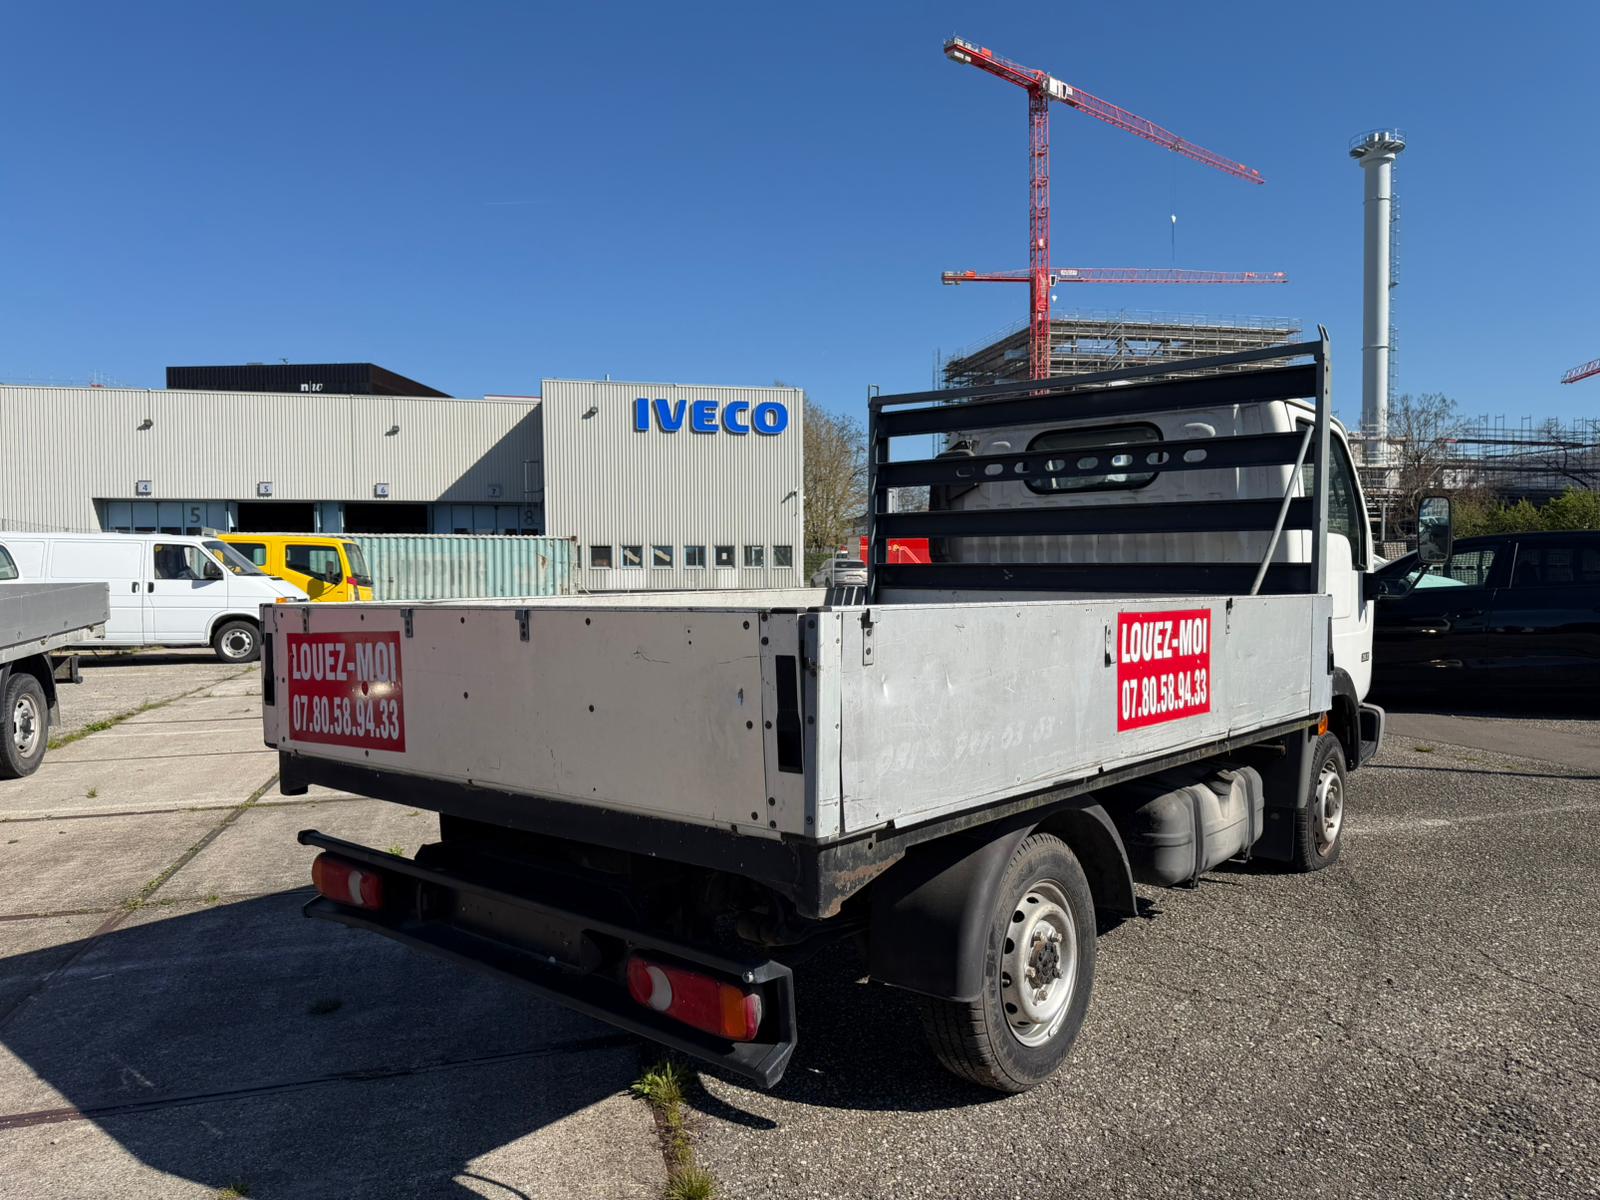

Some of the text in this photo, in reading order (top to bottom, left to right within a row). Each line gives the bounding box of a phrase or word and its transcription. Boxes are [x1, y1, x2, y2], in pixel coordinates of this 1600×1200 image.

[635, 398, 789, 435] IVECO
[190, 507, 201, 524] 5
[291, 641, 397, 682] LOUEZ-MOI
[1121, 617, 1208, 664] LOUEZ-MOI
[1121, 667, 1207, 721] 07.80.58.94.33
[292, 694, 400, 740] 07.80.58.94.33
